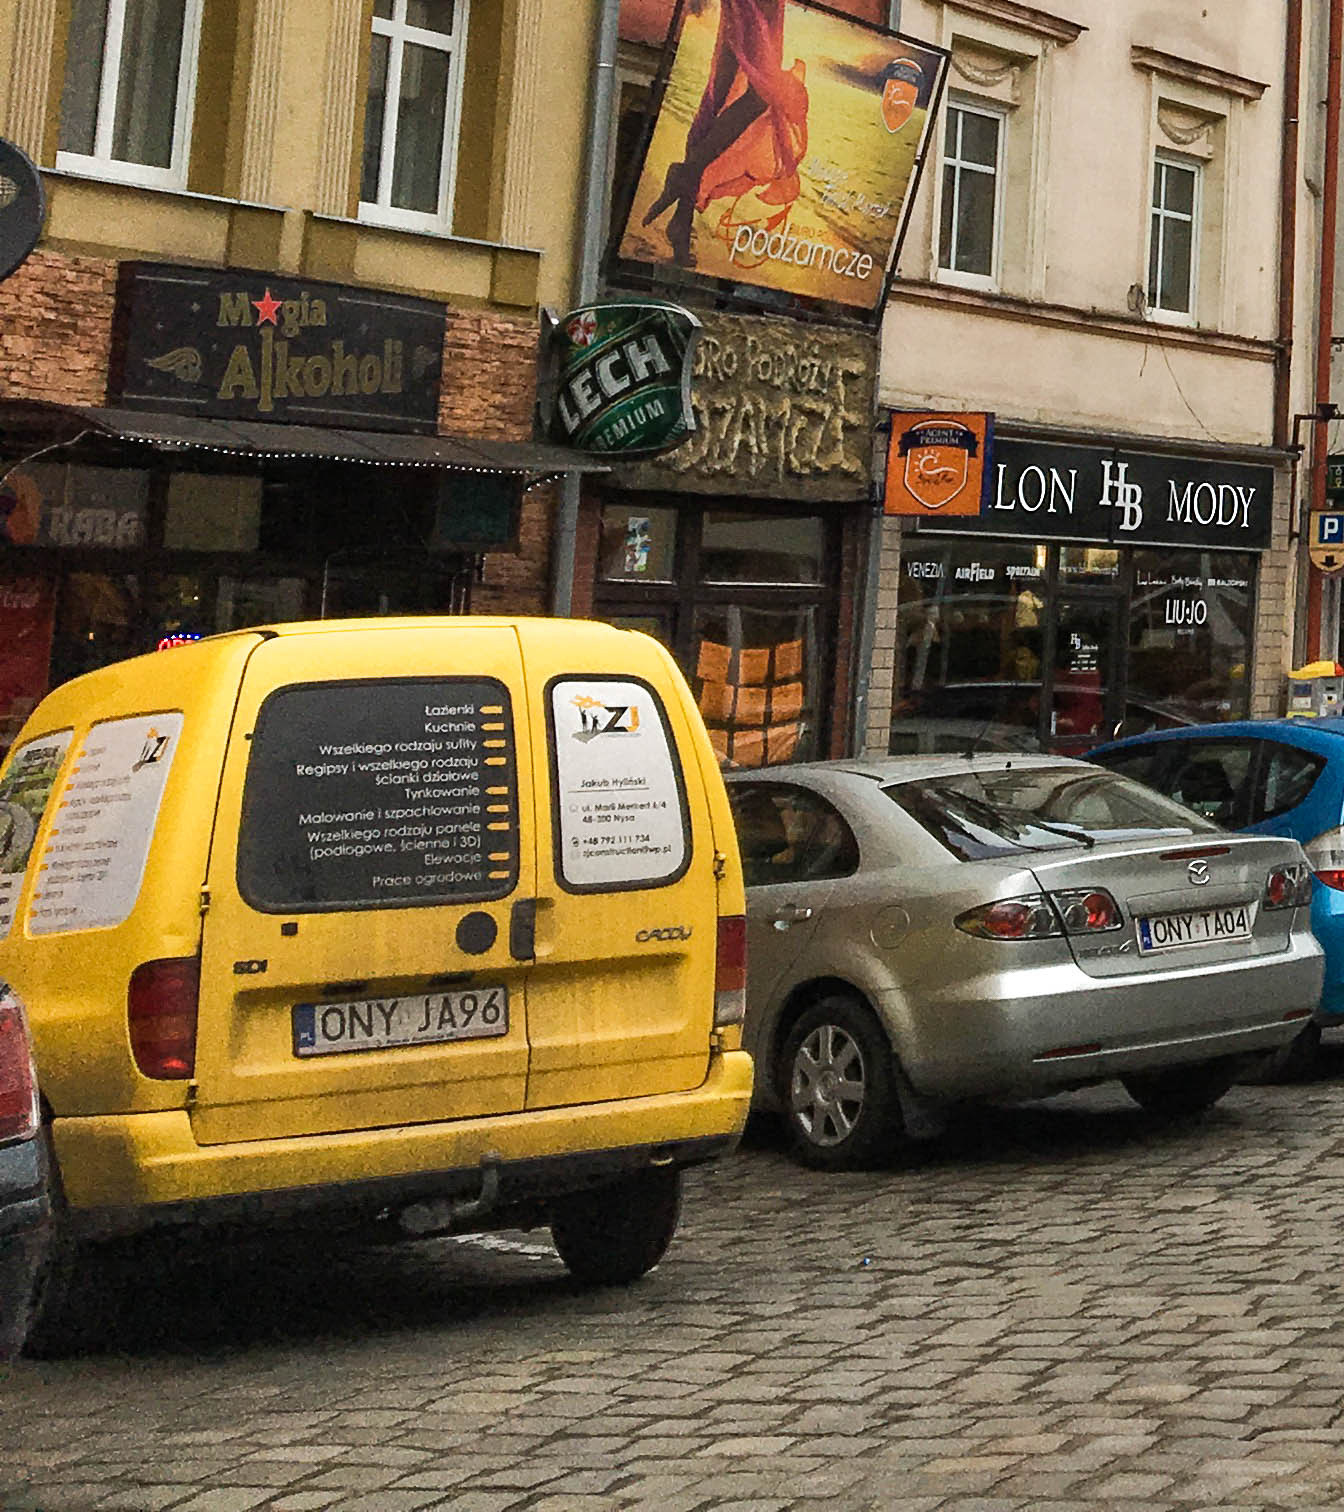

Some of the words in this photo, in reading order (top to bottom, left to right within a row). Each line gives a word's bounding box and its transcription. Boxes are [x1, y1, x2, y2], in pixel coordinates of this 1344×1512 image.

[730, 224, 873, 280] podzamcze
[216, 327, 402, 411] Alkoholi
[557, 334, 672, 435] LECH
[594, 398, 666, 451] REMIUM
[925, 429, 953, 437] AGENT
[988, 464, 1078, 515] LON
[1167, 479, 1256, 528] MODY
[1324, 517, 1339, 540] P
[907, 562, 944, 578] VENEZIA
[425, 704, 475, 717] Łazienki
[424, 721, 476, 734] Kuchnie
[319, 742, 392, 757] Wszelkiego
[395, 740, 443, 754] rodzaju
[445, 738, 477, 751] sufity
[296, 762, 349, 777] Regipsy
[358, 758, 429, 773] wszelkiego
[431, 756, 478, 769] rodzaju
[375, 772, 419, 786] ścianki
[422, 769, 479, 784] działowe
[580, 779, 610, 788] Jakub
[404, 786, 480, 800] Tynkowanie
[299, 809, 375, 826] Malowanie
[384, 803, 481, 820] szpachlowanie
[613, 814, 636, 824] Nysa
[307, 826, 381, 843] Wszelkiego
[384, 824, 433, 839] rodzaju
[435, 821, 481, 835] panele
[601, 836, 616, 845] 792
[400, 838, 450, 854] ścienne
[459, 835, 482, 850] 3D)
[424, 850, 482, 866] Elewacje
[372, 873, 412, 888] Prace
[414, 870, 482, 887] ogrodowe
[1153, 914, 1193, 944] ONY
[1201, 909, 1247, 936] TA04
[233, 959, 267, 974] SDI
[320, 1001, 397, 1042] ONY
[417, 991, 500, 1031] JA96
